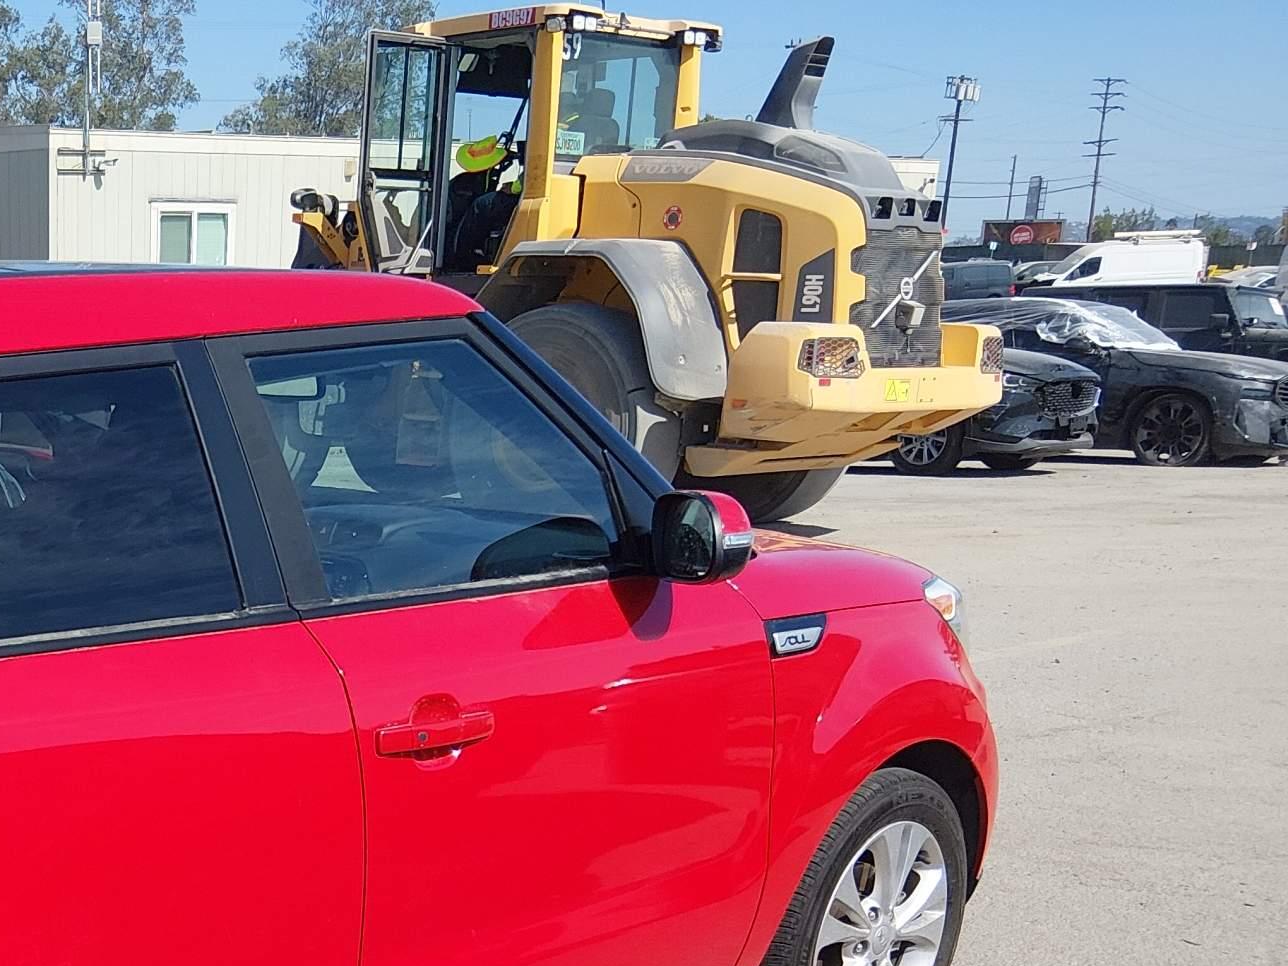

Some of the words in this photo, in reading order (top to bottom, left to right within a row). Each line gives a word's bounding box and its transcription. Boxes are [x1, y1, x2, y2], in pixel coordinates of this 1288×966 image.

[562, 32, 582, 61] 59
[632, 162, 696, 175] VOLVO
[800, 274, 825, 313] L90H
